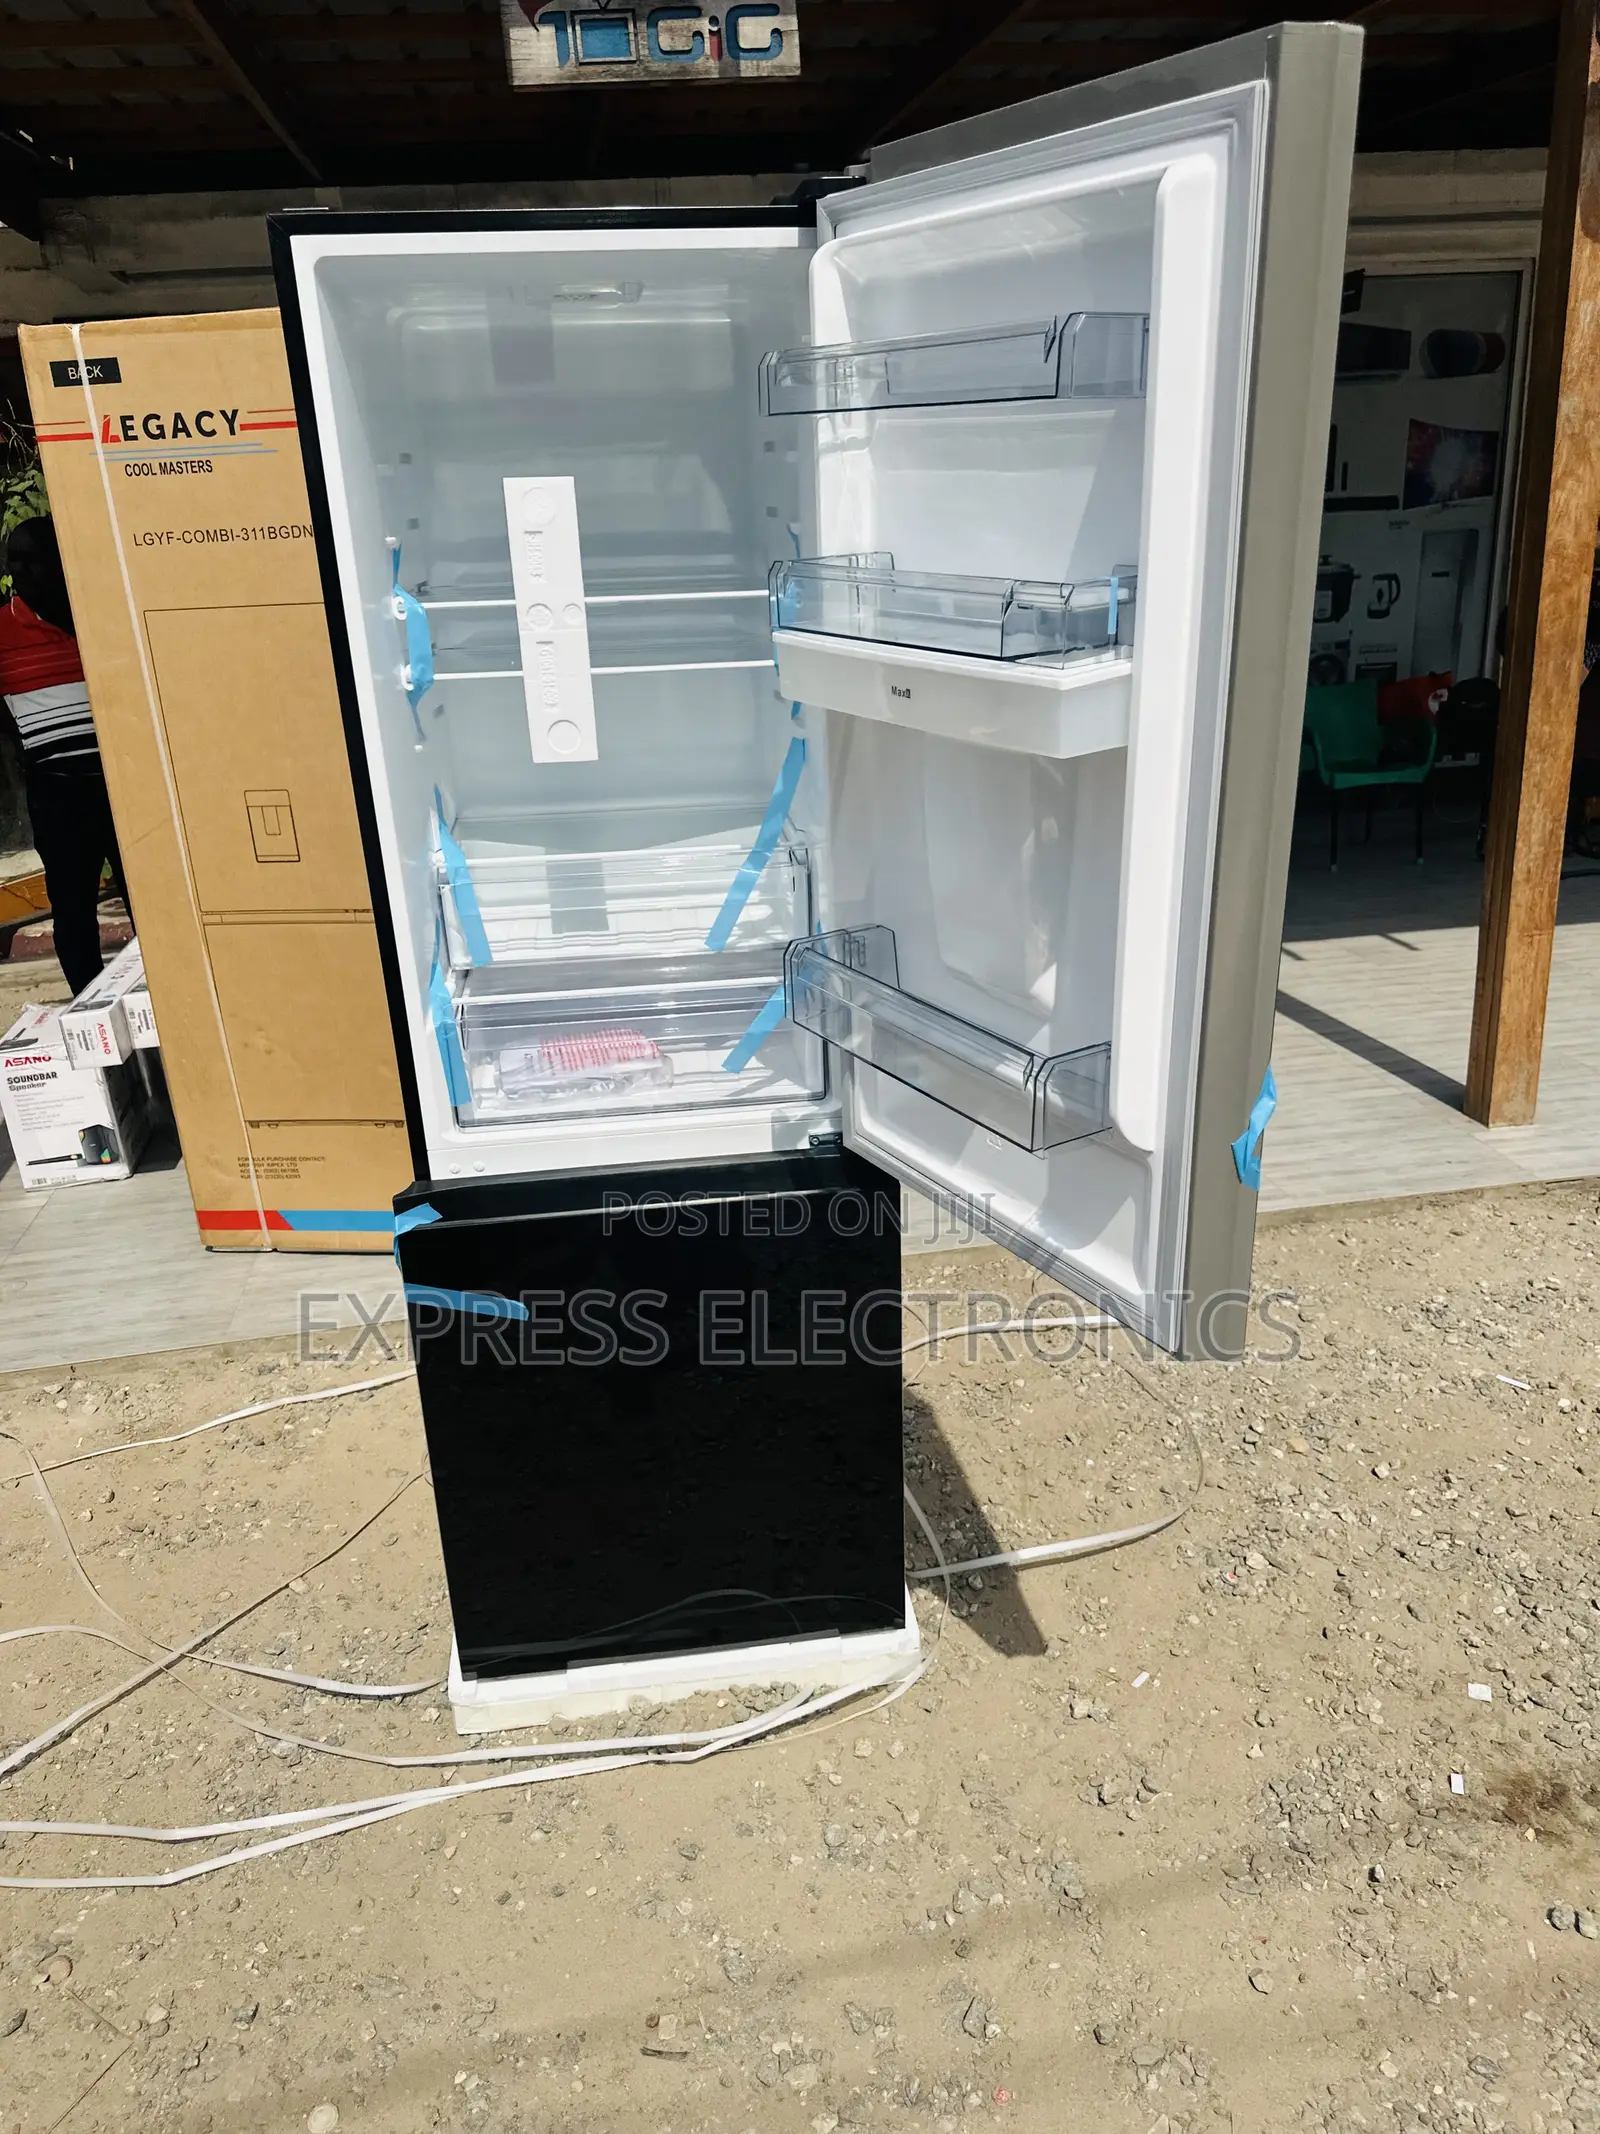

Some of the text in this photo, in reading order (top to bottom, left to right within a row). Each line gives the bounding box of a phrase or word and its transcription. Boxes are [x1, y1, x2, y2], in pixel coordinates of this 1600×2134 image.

[67, 365, 103, 380] BACK
[101, 409, 239, 444] LEGACY
[124, 460, 213, 477] COOL MASTERS
[97, 1022, 111, 1055] ASANO
[5, 1056, 52, 1067] ASANO
[7, 1071, 58, 1085] SOUNDBAR
